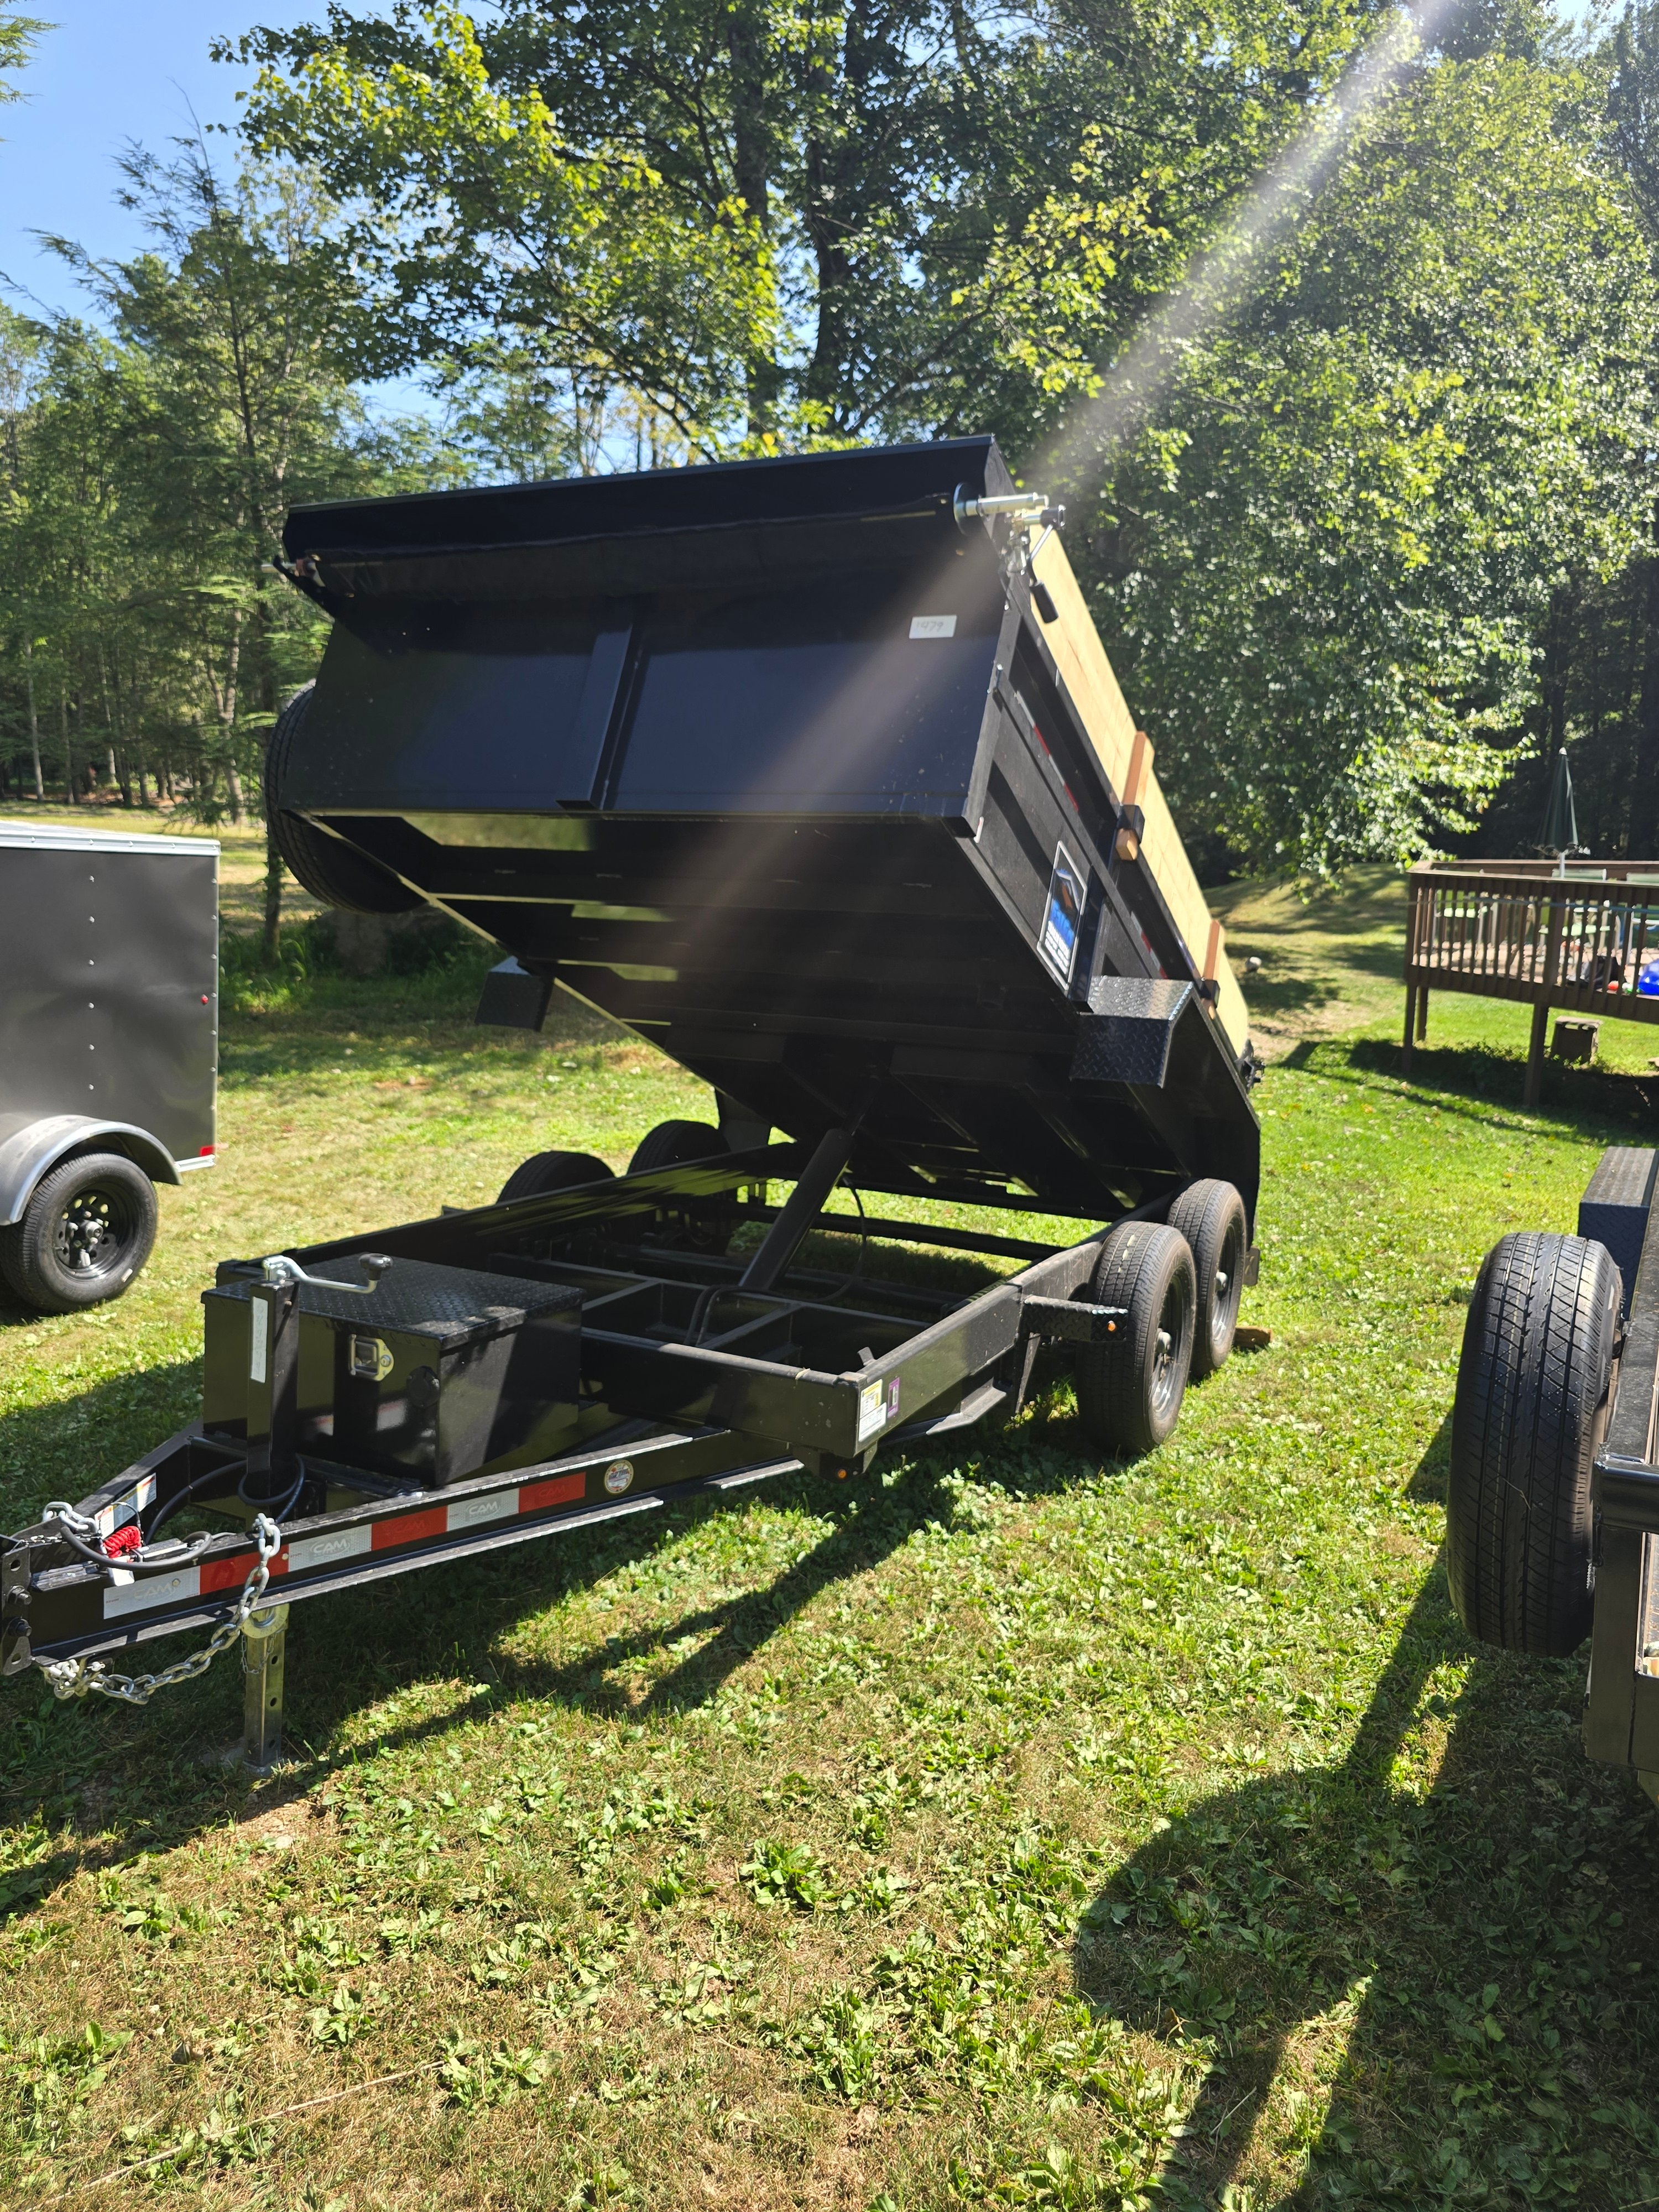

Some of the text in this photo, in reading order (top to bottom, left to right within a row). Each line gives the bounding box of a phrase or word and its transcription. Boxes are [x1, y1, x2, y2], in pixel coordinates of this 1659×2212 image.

[539, 1485, 565, 1497] CAM
[469, 1501, 498, 1515] CAM
[313, 1538, 347, 1554] CAM
[134, 1582, 171, 1599] CAM
